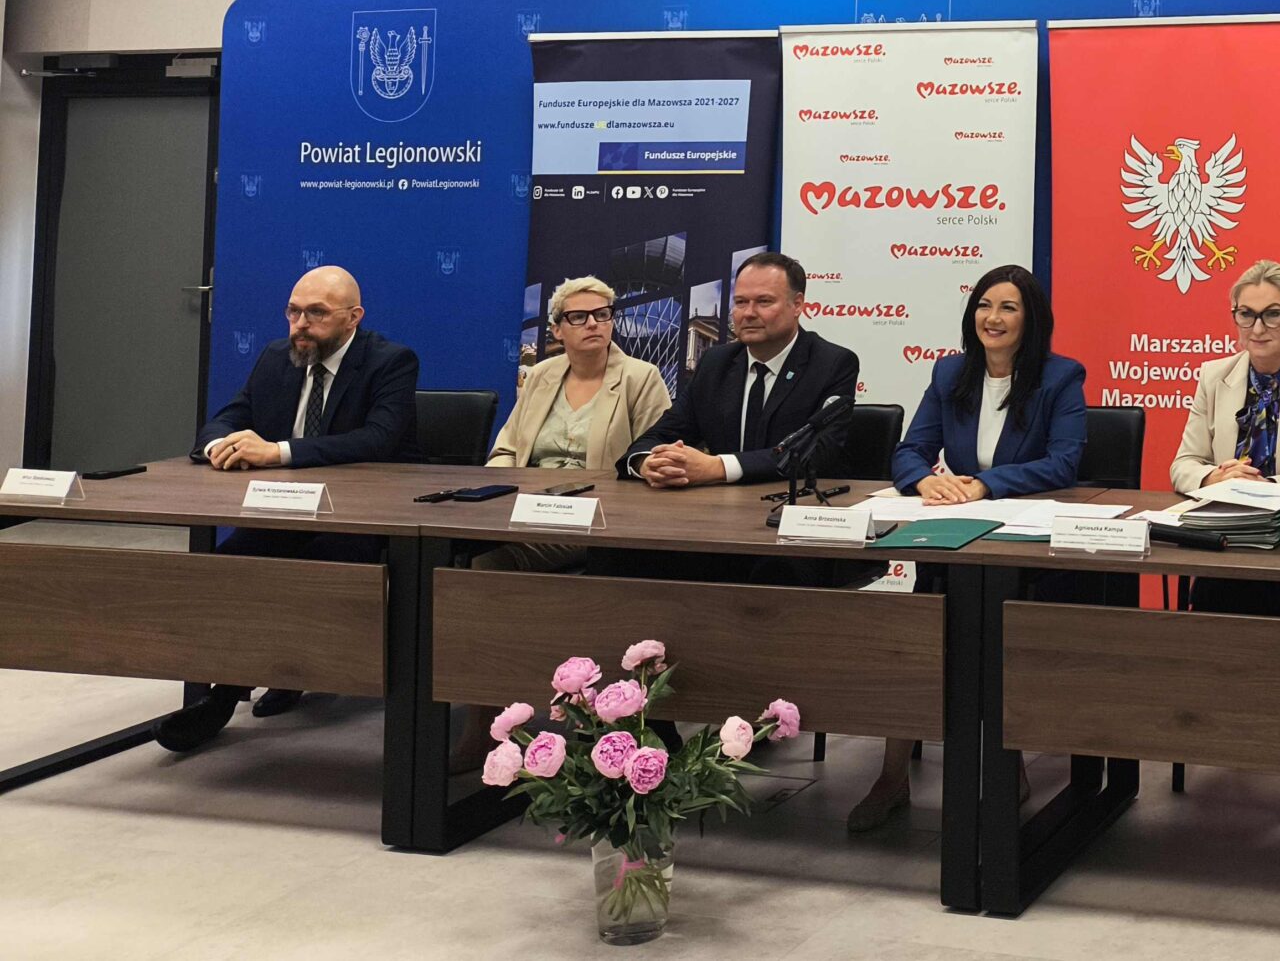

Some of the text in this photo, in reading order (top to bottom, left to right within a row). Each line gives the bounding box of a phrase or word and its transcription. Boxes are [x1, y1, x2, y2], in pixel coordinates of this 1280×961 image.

[793, 44, 886, 61] Mazowsze.
[917, 81, 1022, 99] Mazowsze.
[539, 97, 740, 109] Fundusze Europejskie dla Mazowsza 2021-2027
[799, 109, 879, 123] Mazowsze.
[300, 140, 482, 168] Powiat Legionowski
[644, 150, 737, 161] Fundusze Europejskie
[300, 179, 394, 190] www.powiat-legionowski.pl
[412, 178, 480, 190] PowiatLegionowski
[800, 181, 1006, 216] Mazowsze.
[936, 214, 998, 226] serce Polski
[890, 243, 983, 259] Mazowsze.
[805, 272, 843, 281] zowsze.
[802, 301, 910, 319] Mazowsze.
[1130, 334, 1237, 354] Marszałek
[1109, 361, 1202, 385] Wojewó
[1102, 388, 1194, 409] Mazowie
[1074, 524, 1103, 532] Agnieszka
